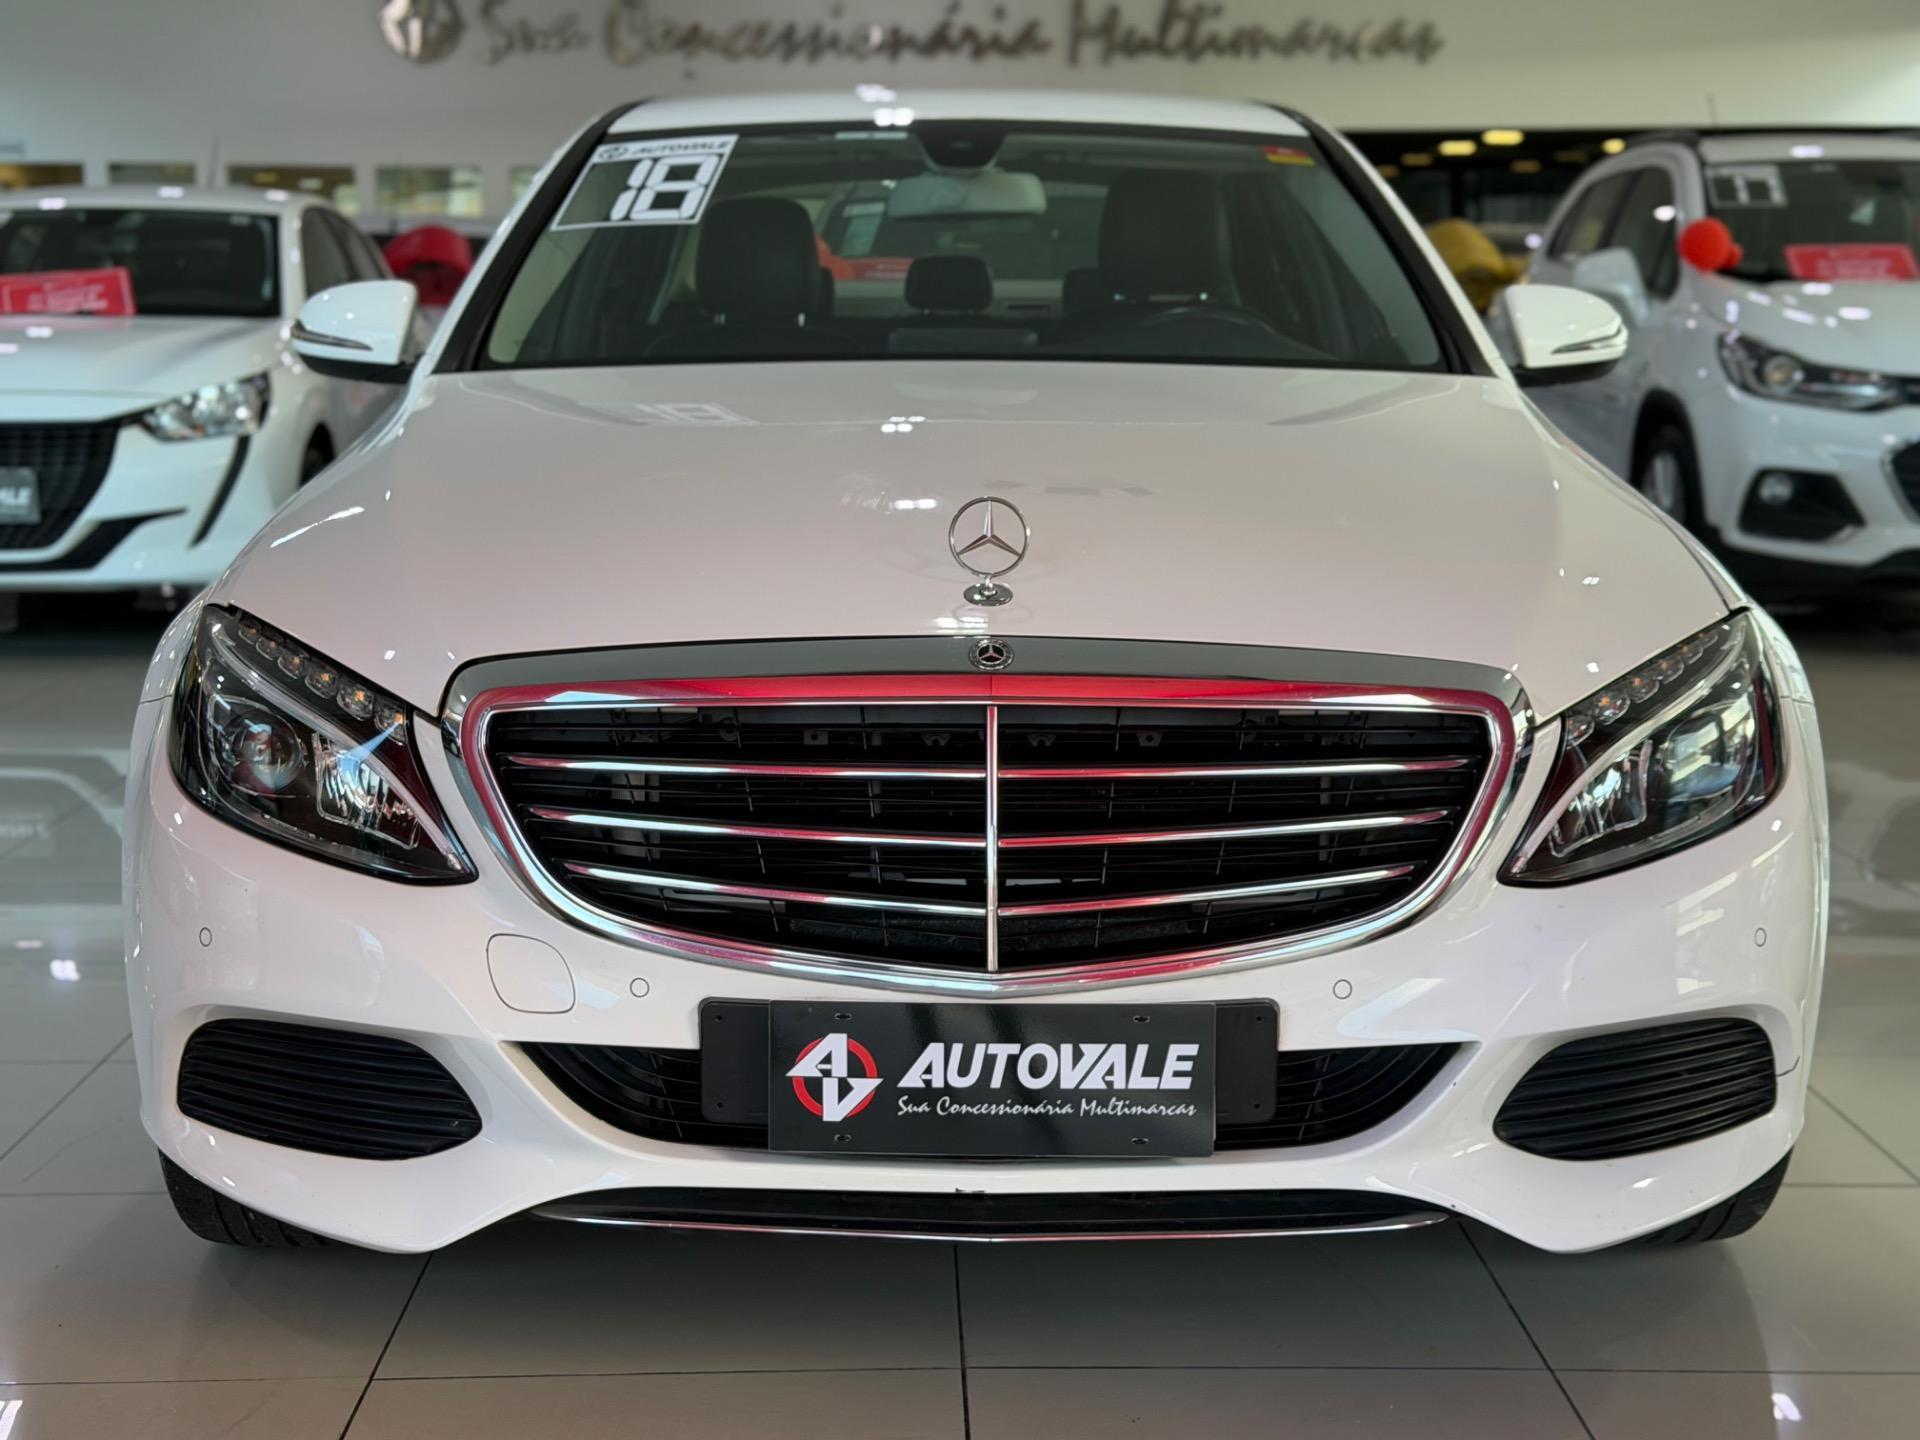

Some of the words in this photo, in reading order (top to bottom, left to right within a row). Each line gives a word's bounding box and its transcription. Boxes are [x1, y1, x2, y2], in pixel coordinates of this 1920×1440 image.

[1066, 0, 1447, 66] Multimarcas
[609, 156, 721, 221] 18
[896, 1042, 1199, 1090] AUTOVALE
[897, 1095, 932, 1116] Sua
[936, 1095, 1075, 1116] Concessionária
[1079, 1096, 1198, 1117] Multimarcas
